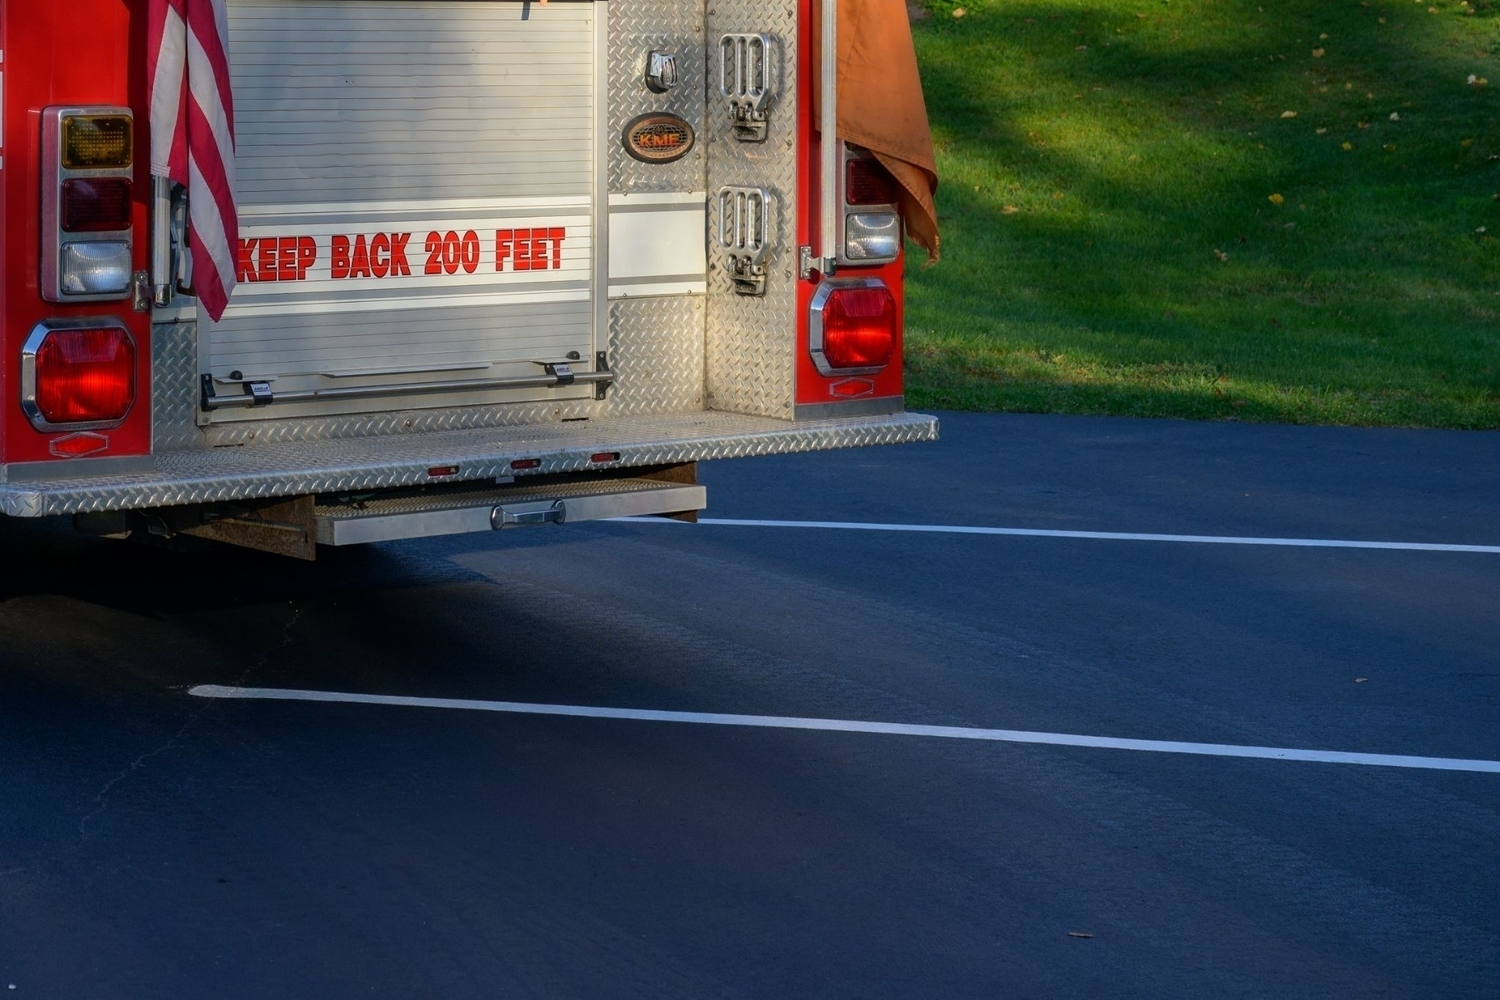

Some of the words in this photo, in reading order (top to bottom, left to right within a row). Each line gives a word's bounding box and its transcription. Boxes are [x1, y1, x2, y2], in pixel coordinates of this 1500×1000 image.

[639, 133, 681, 147] KME
[237, 236, 317, 283] KEEP
[331, 232, 411, 279] BACK
[424, 230, 480, 275] 200
[495, 227, 566, 272] FEET
